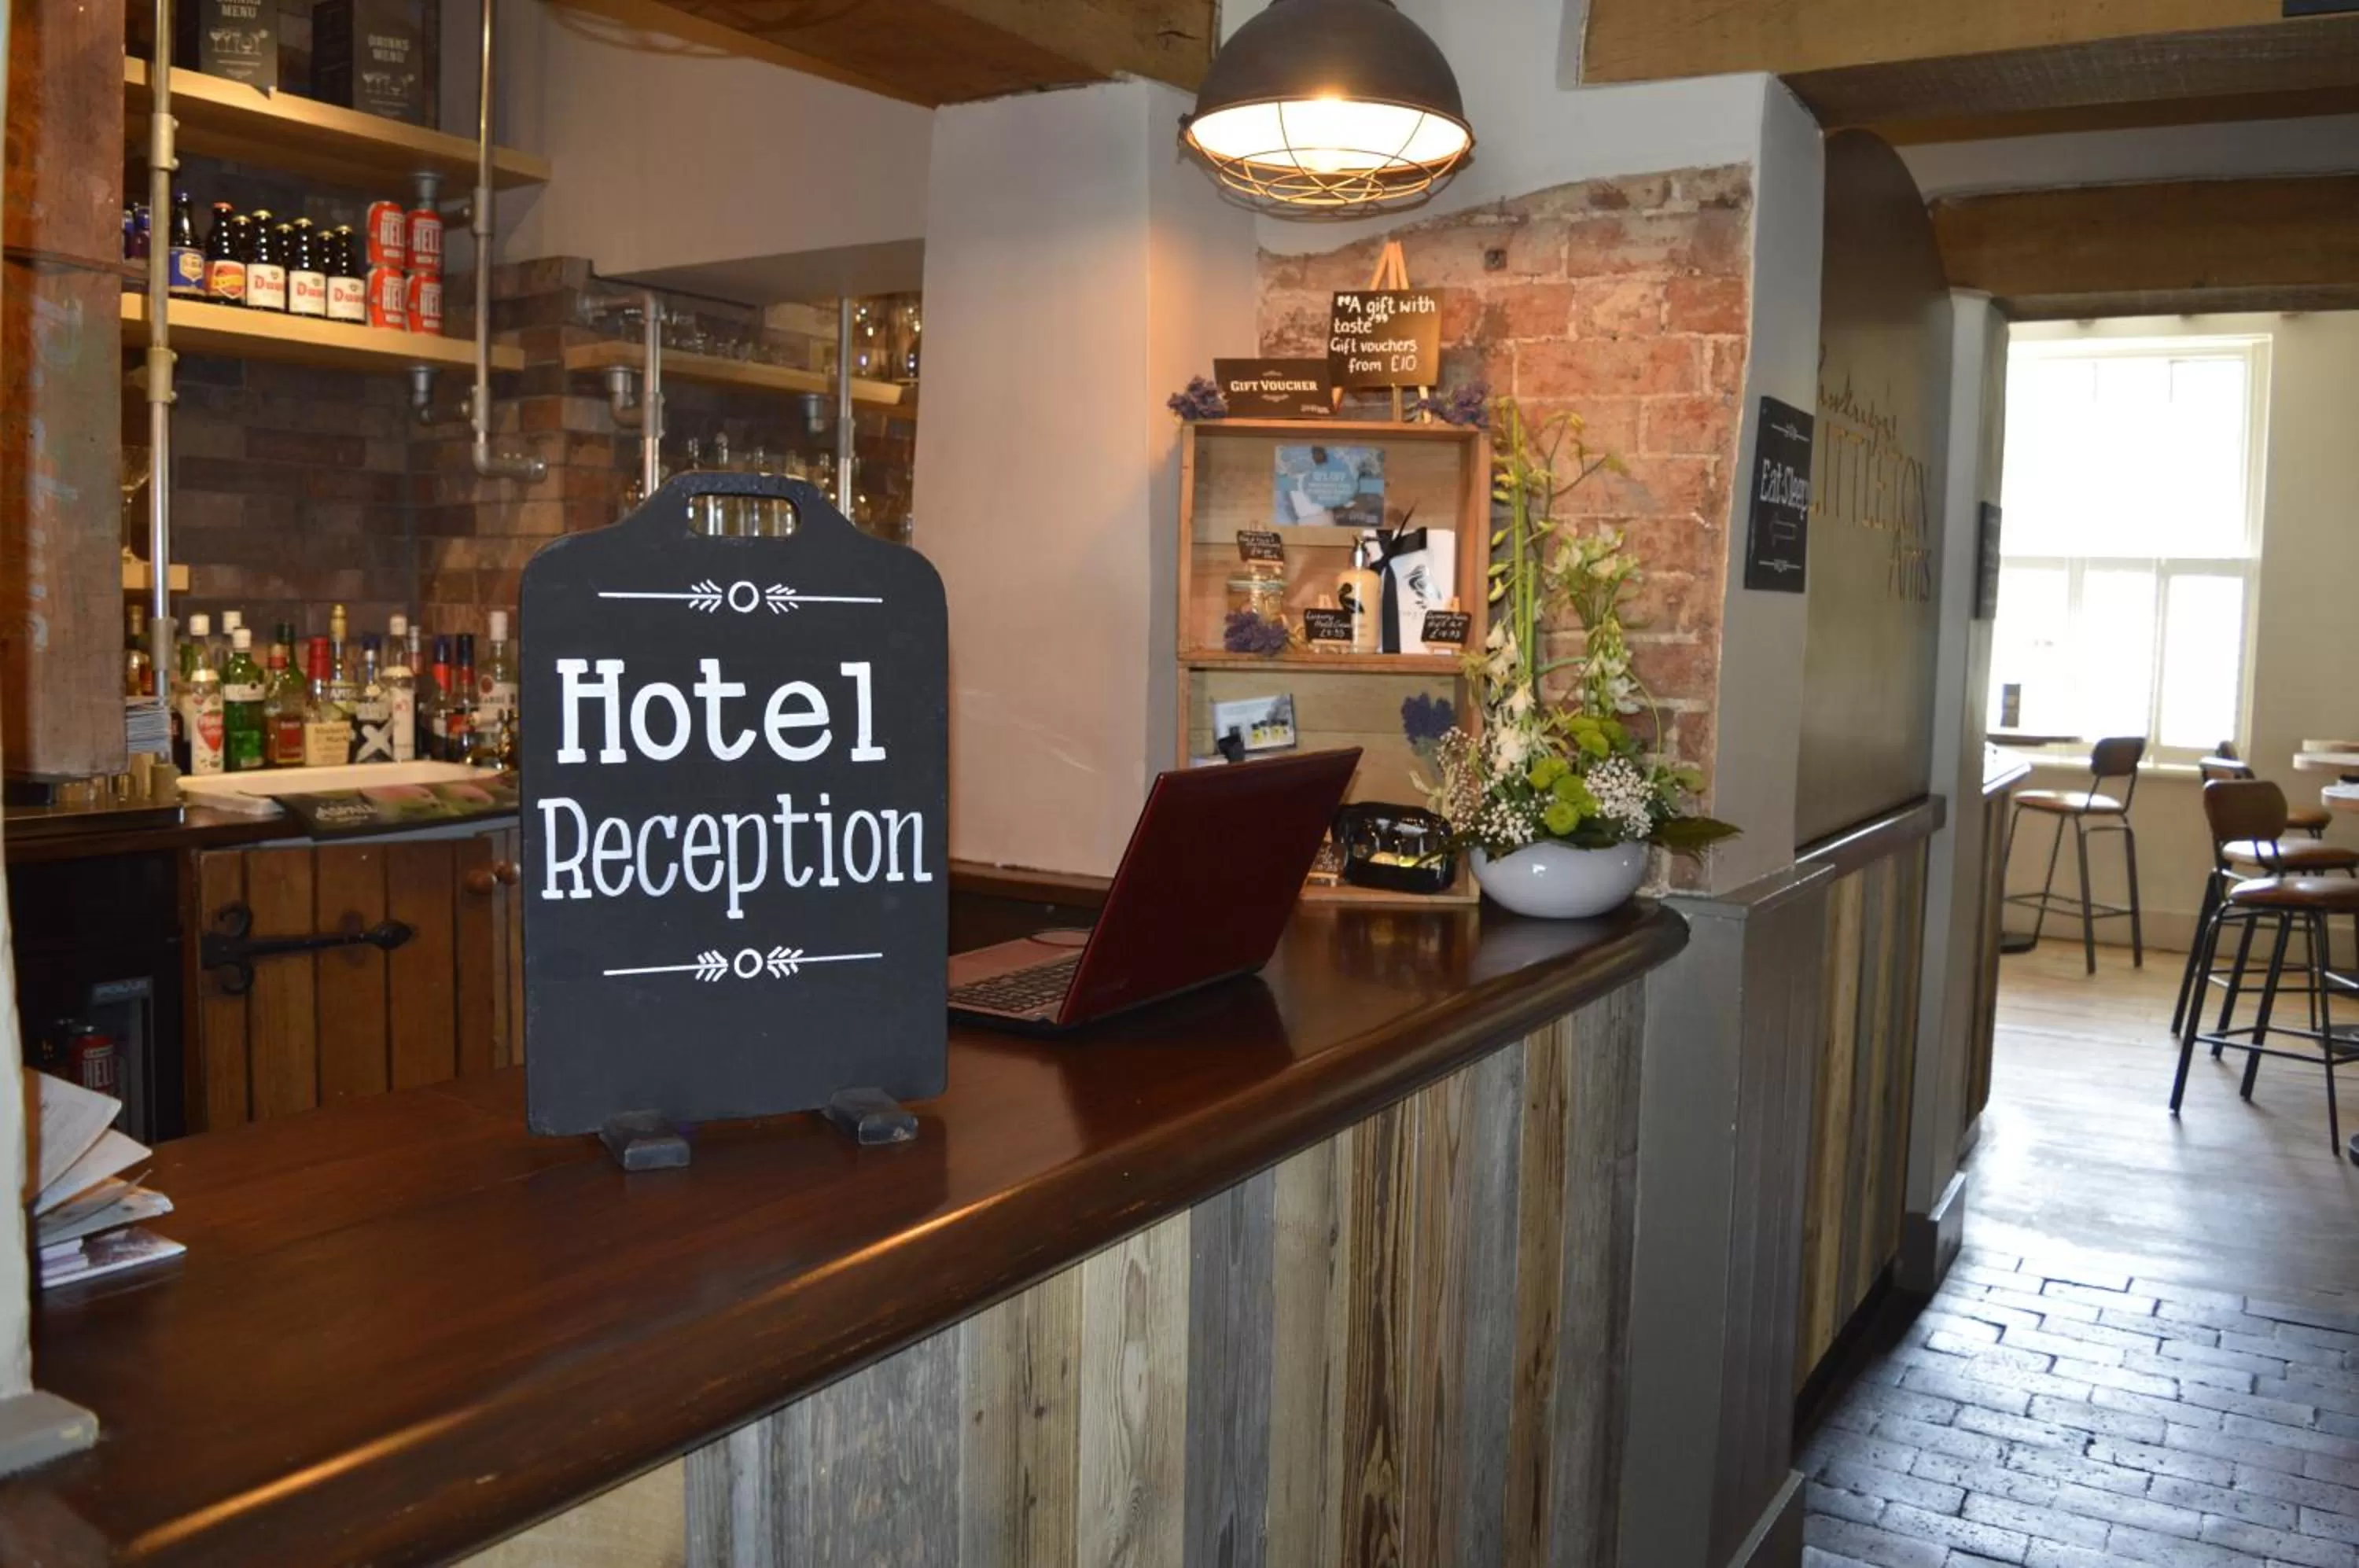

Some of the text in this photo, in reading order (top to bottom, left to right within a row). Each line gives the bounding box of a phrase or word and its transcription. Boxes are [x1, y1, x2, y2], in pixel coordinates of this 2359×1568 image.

[221, 4, 257, 18] MENU
[1366, 296, 1396, 321] gift
[1399, 296, 1436, 313] with
[1330, 337, 1418, 355] Gift vouchers
[1348, 354, 1417, 374] from £10
[1231, 380, 1318, 392] GIFT VOUCHER
[556, 657, 885, 764] Hotel
[537, 793, 933, 918] Reception
